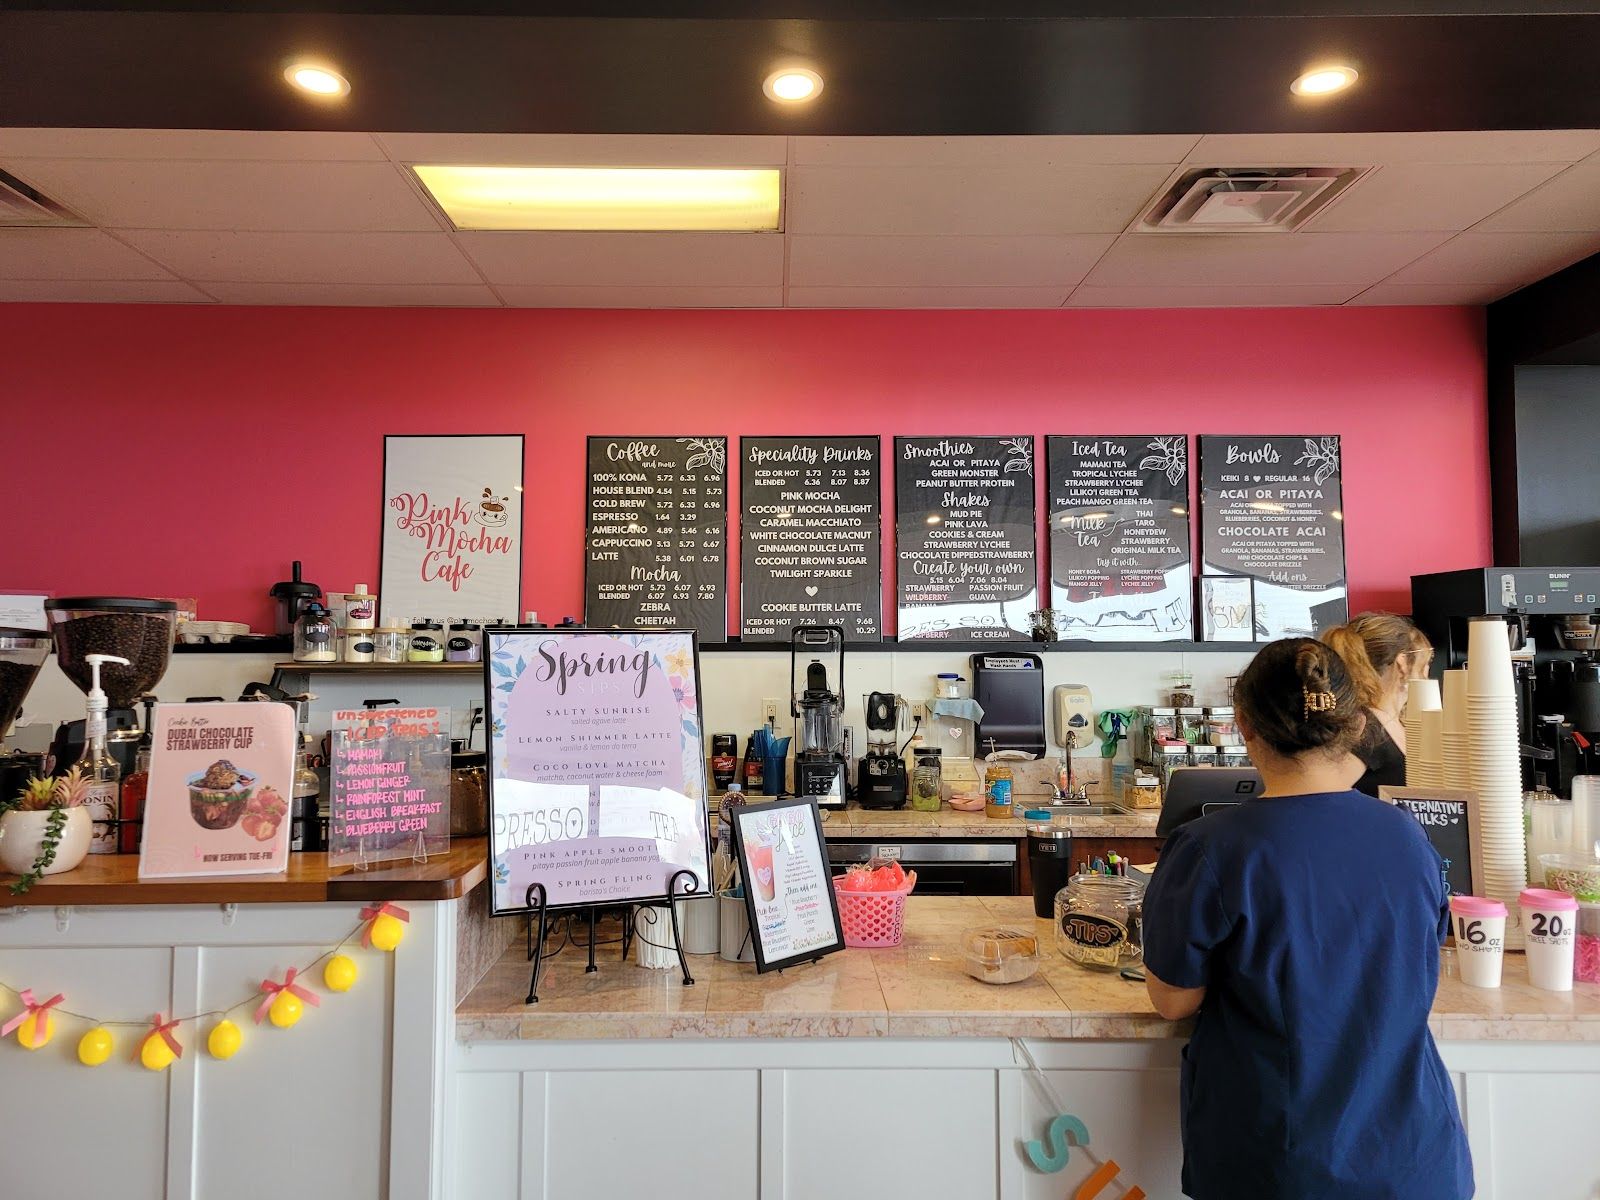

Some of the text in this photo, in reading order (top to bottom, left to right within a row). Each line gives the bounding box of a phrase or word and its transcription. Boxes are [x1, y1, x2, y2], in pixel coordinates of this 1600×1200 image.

[607, 442, 660, 461] Coffee
[904, 440, 975, 460] Smoothies
[1072, 441, 1127, 457] Iced Tea
[1226, 443, 1282, 464] Bowls
[749, 445, 873, 465] Speciality Drinks
[642, 460, 656, 469] and
[593, 486, 624, 495] HOUSE
[626, 486, 654, 495] BLEND
[1220, 490, 1324, 499] ACAI OR PITAYA
[781, 492, 840, 500] PINK MOCHA
[942, 492, 991, 508] Shakes
[593, 500, 618, 508] COLD
[620, 500, 646, 508] BREW
[749, 506, 796, 514] COCONUT
[834, 504, 872, 513] DELIGHT
[390, 493, 473, 530] Pink
[593, 512, 638, 521] ESPRESSO
[760, 518, 862, 527] CARAMEL MACCHIATO
[1070, 516, 1106, 531] Milk
[592, 526, 648, 534] AMERICANO
[1218, 527, 1326, 536] CHOCOLATE ACAI
[409, 522, 513, 559] Mocha
[750, 532, 872, 540] WHITE CHOCOLATE MACNUT
[1074, 531, 1101, 547] Tea
[592, 539, 653, 547] CAPPUCCINO
[980, 541, 1010, 549] LYCHEE
[758, 544, 864, 553] CINNAMON DULCE LATTE
[1166, 546, 1181, 554] TEA
[592, 552, 619, 561] LATTE
[837, 557, 867, 565] SUGAR
[422, 550, 474, 592] Cafe
[630, 565, 681, 582] Mocha
[913, 560, 1025, 577] Create your own
[770, 570, 852, 578] TWILIGHT SPARKLE
[640, 603, 671, 612] ZEBRA
[761, 604, 862, 612] COOKIE BUTTER LATTE
[634, 616, 676, 625] CHEETAH
[536, 640, 657, 699] Spring
[546, 707, 651, 716] SALTY SUNRISE
[592, 718, 611, 726] agave
[168, 727, 254, 740] DUBAI CHOCOLATE
[166, 738, 253, 751] STRAWBERRY CUP
[346, 776, 411, 791] LEMON GINGER
[404, 790, 426, 802] MINT
[346, 802, 442, 821] ENGLISH BREAKFAST
[1392, 799, 1465, 815] TERNATIVE
[346, 818, 428, 837] BLUEBERRY GREEN
[1040, 844, 1056, 852] YETI
[203, 852, 273, 862] NOW SERVING TUE-FRI
[524, 848, 603, 860] PINK APPLE
[1532, 912, 1563, 937] 20
[1458, 917, 1486, 945] 16
